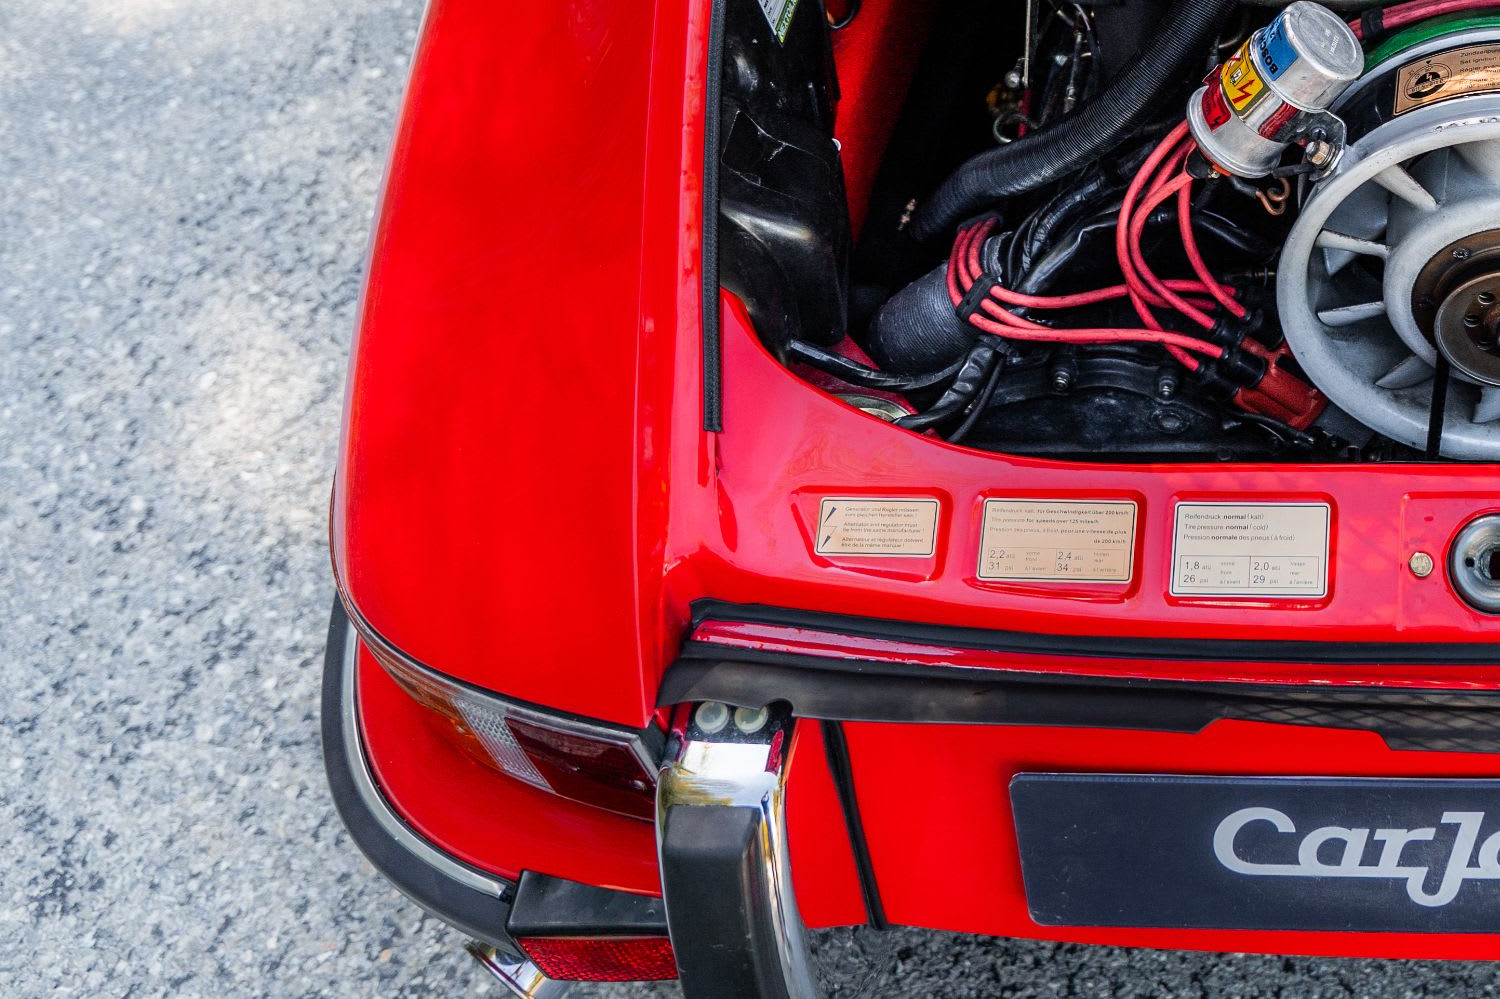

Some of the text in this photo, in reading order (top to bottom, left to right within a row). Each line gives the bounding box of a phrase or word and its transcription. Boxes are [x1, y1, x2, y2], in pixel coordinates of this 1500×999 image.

[1259, 36, 1279, 75] BOSCH
[1472, 56, 1497, 64] ignition
[989, 550, 1005, 559] 2,2
[1057, 551, 1072, 561] 2,4
[989, 561, 1068, 572] 31 34
[1185, 561, 1200, 571] 1,8
[1254, 562, 1270, 571] 2,0
[1183, 575, 1196, 583] 26
[1253, 575, 1266, 584] 29
